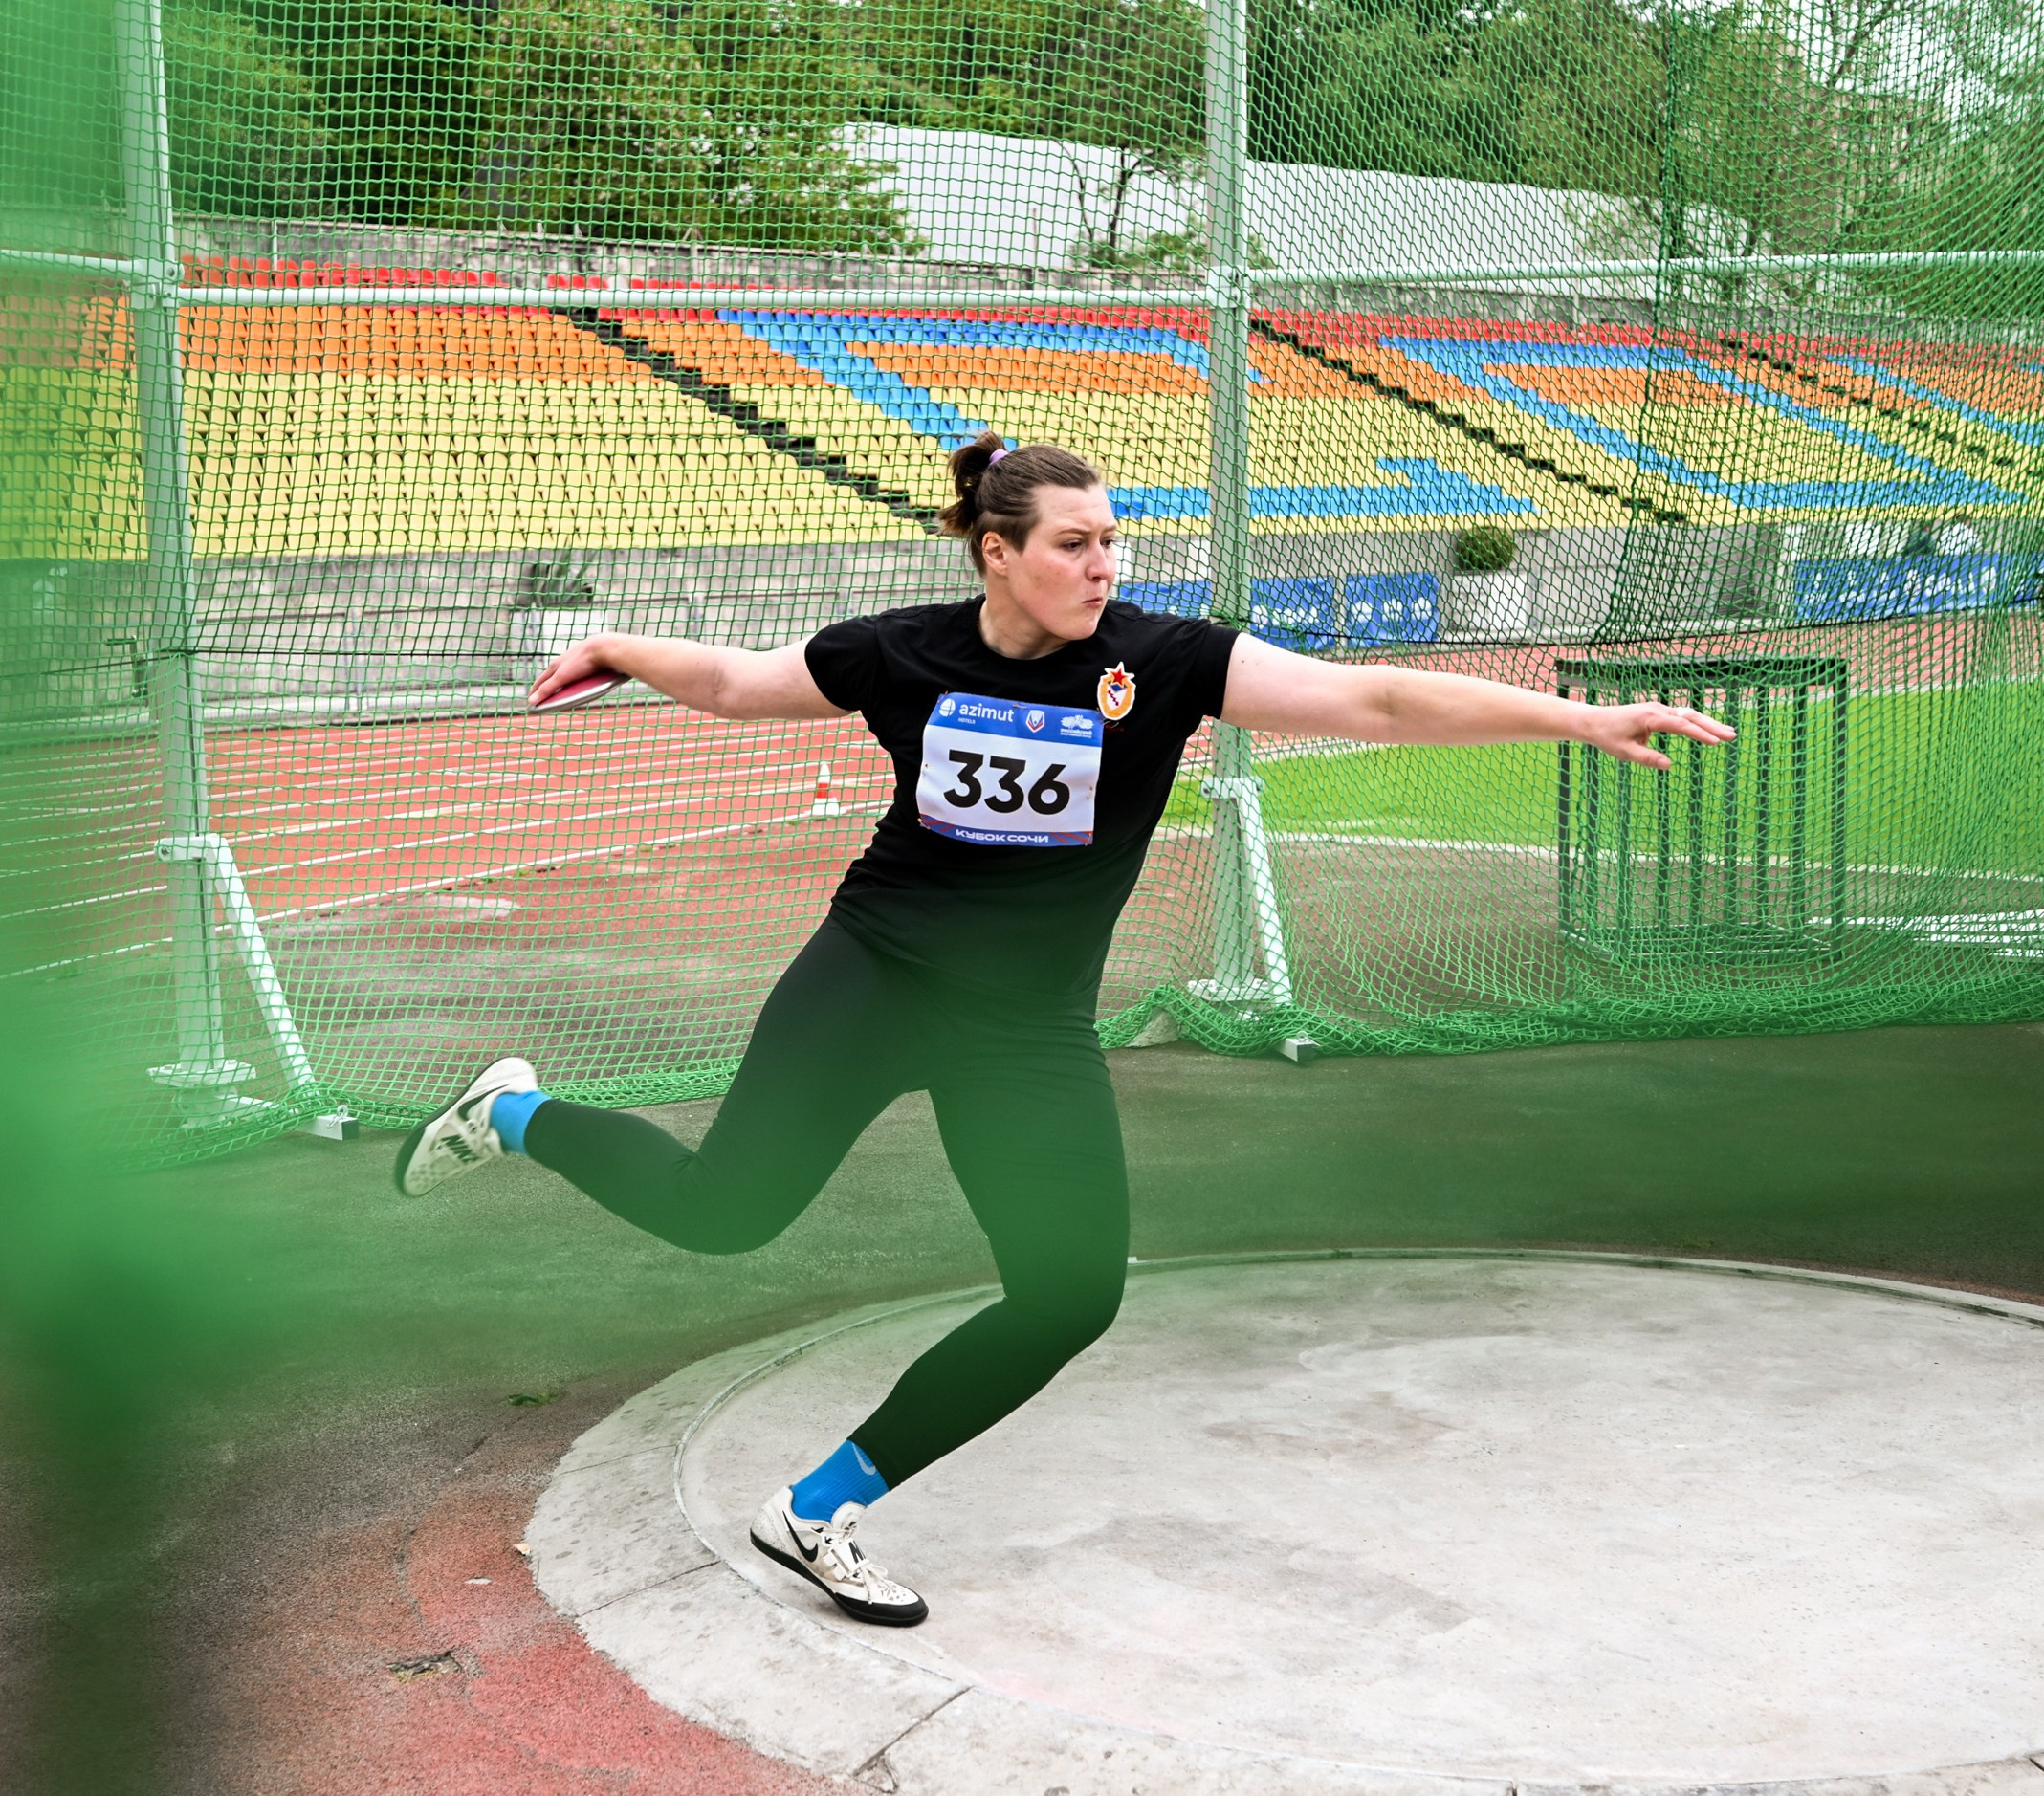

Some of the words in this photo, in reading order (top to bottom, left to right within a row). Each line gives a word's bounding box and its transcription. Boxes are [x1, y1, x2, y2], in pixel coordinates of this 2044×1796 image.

[959, 703, 1014, 722] azimut
[944, 749, 1070, 815] 336
[956, 829, 1006, 842] КУБОК
[1007, 835, 1049, 843] СОЧИ
